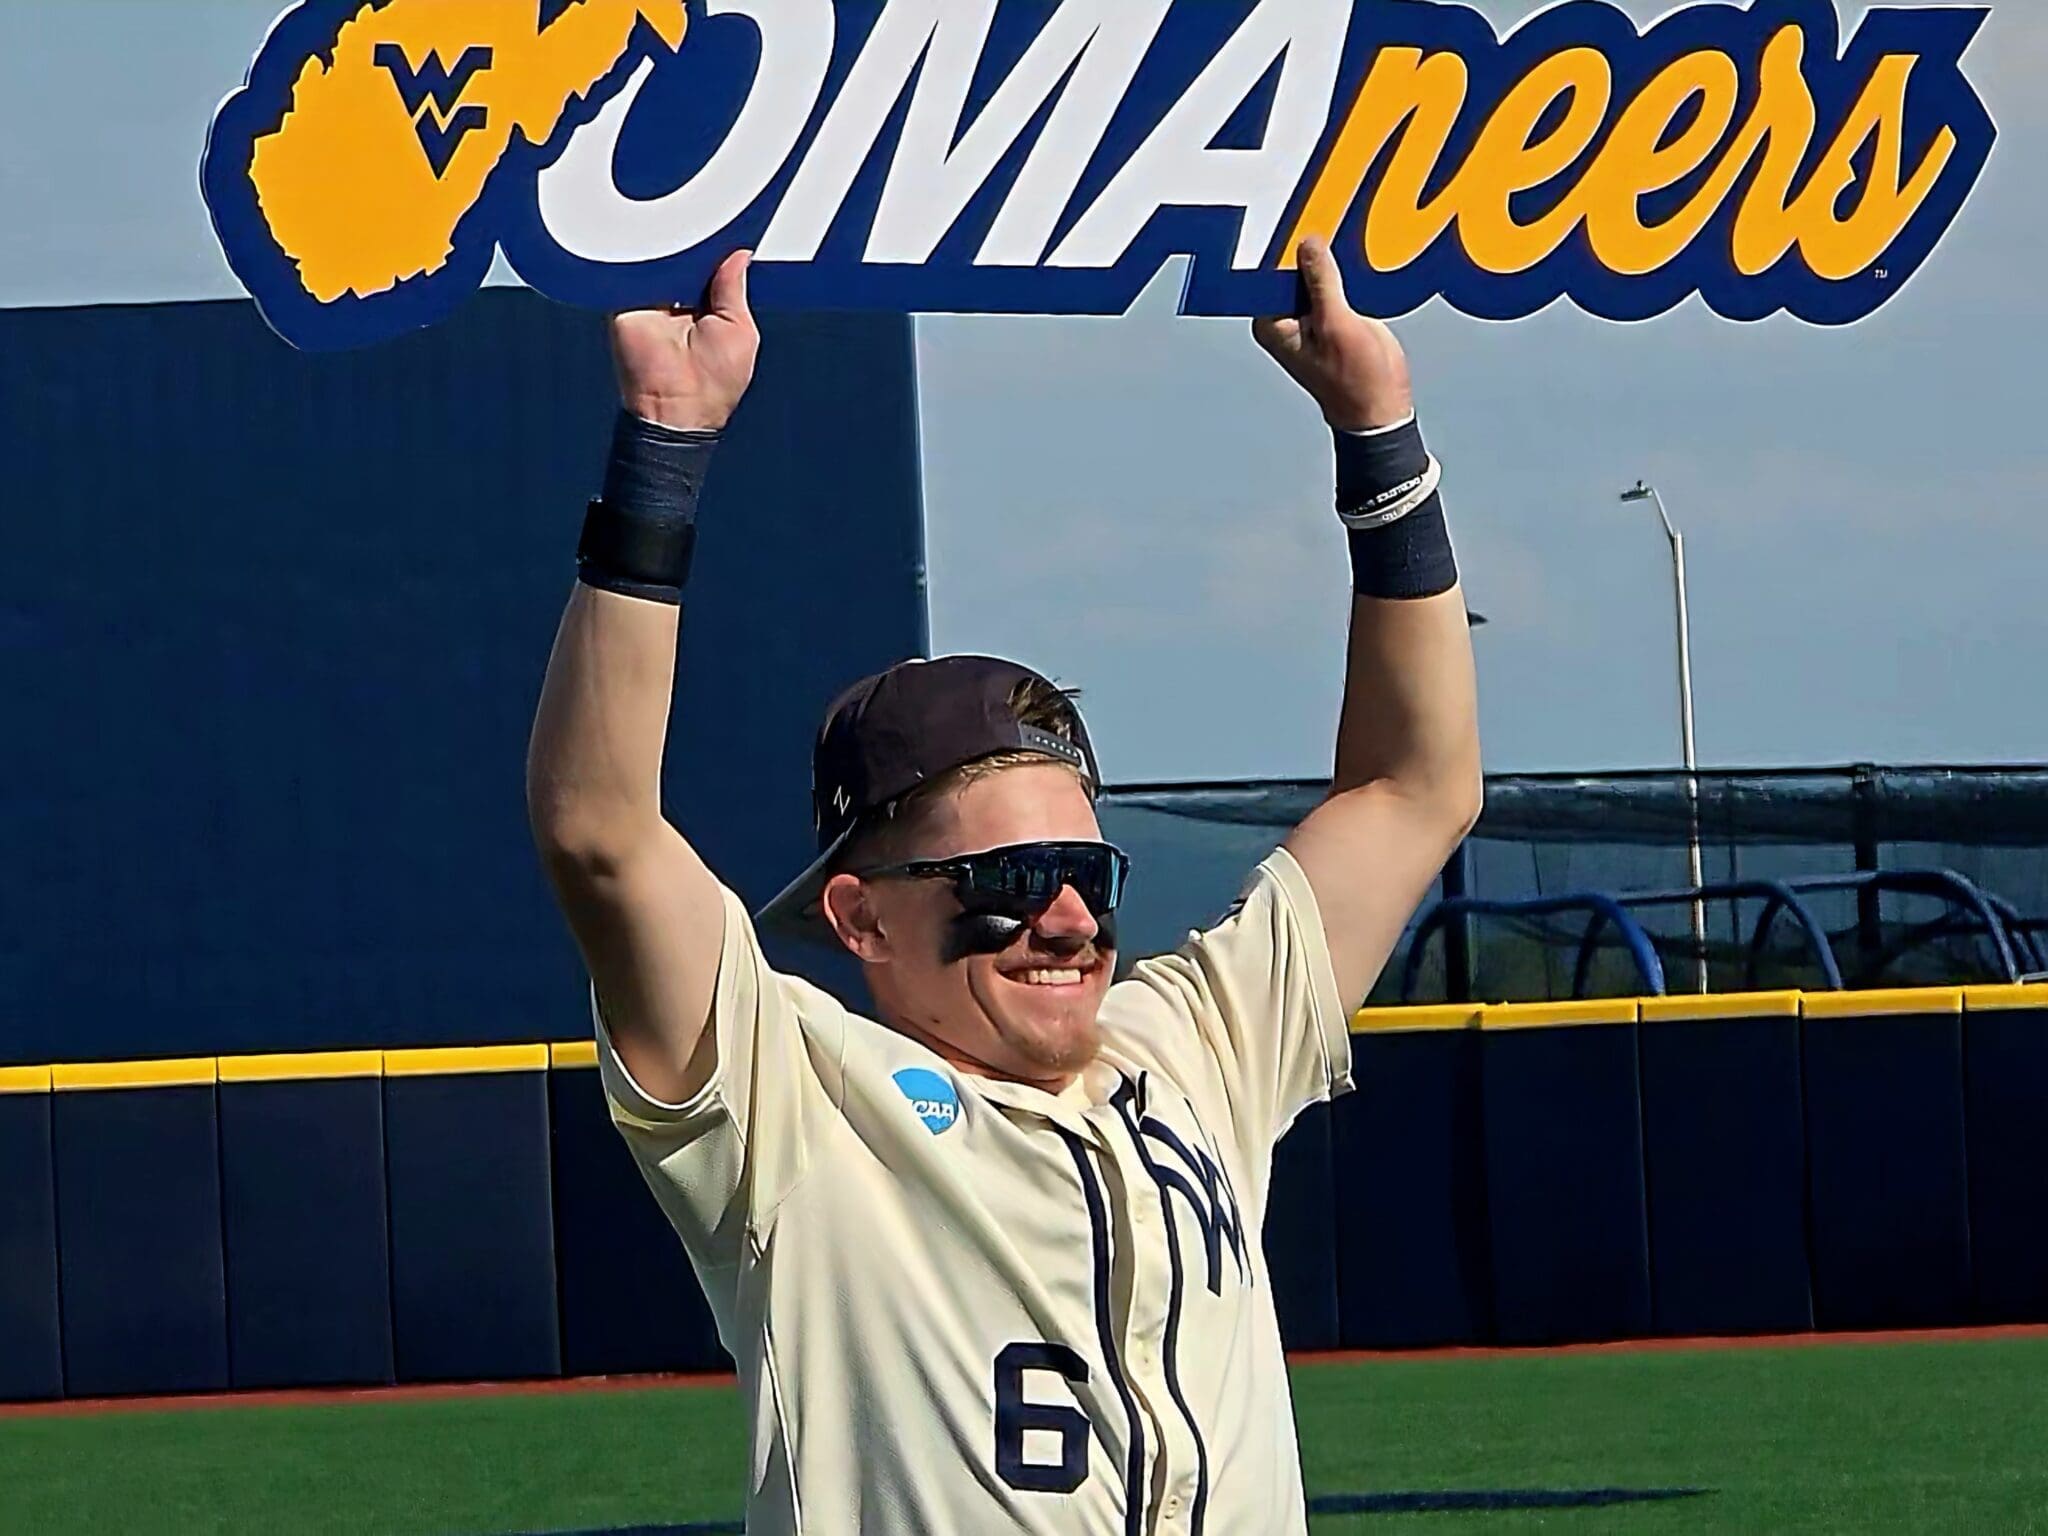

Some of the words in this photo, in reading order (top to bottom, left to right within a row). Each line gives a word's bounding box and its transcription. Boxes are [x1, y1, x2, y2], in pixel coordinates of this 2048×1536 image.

[374, 44, 494, 181] WV
[911, 1099, 956, 1122] CAA
[993, 1341, 1090, 1495] 6
